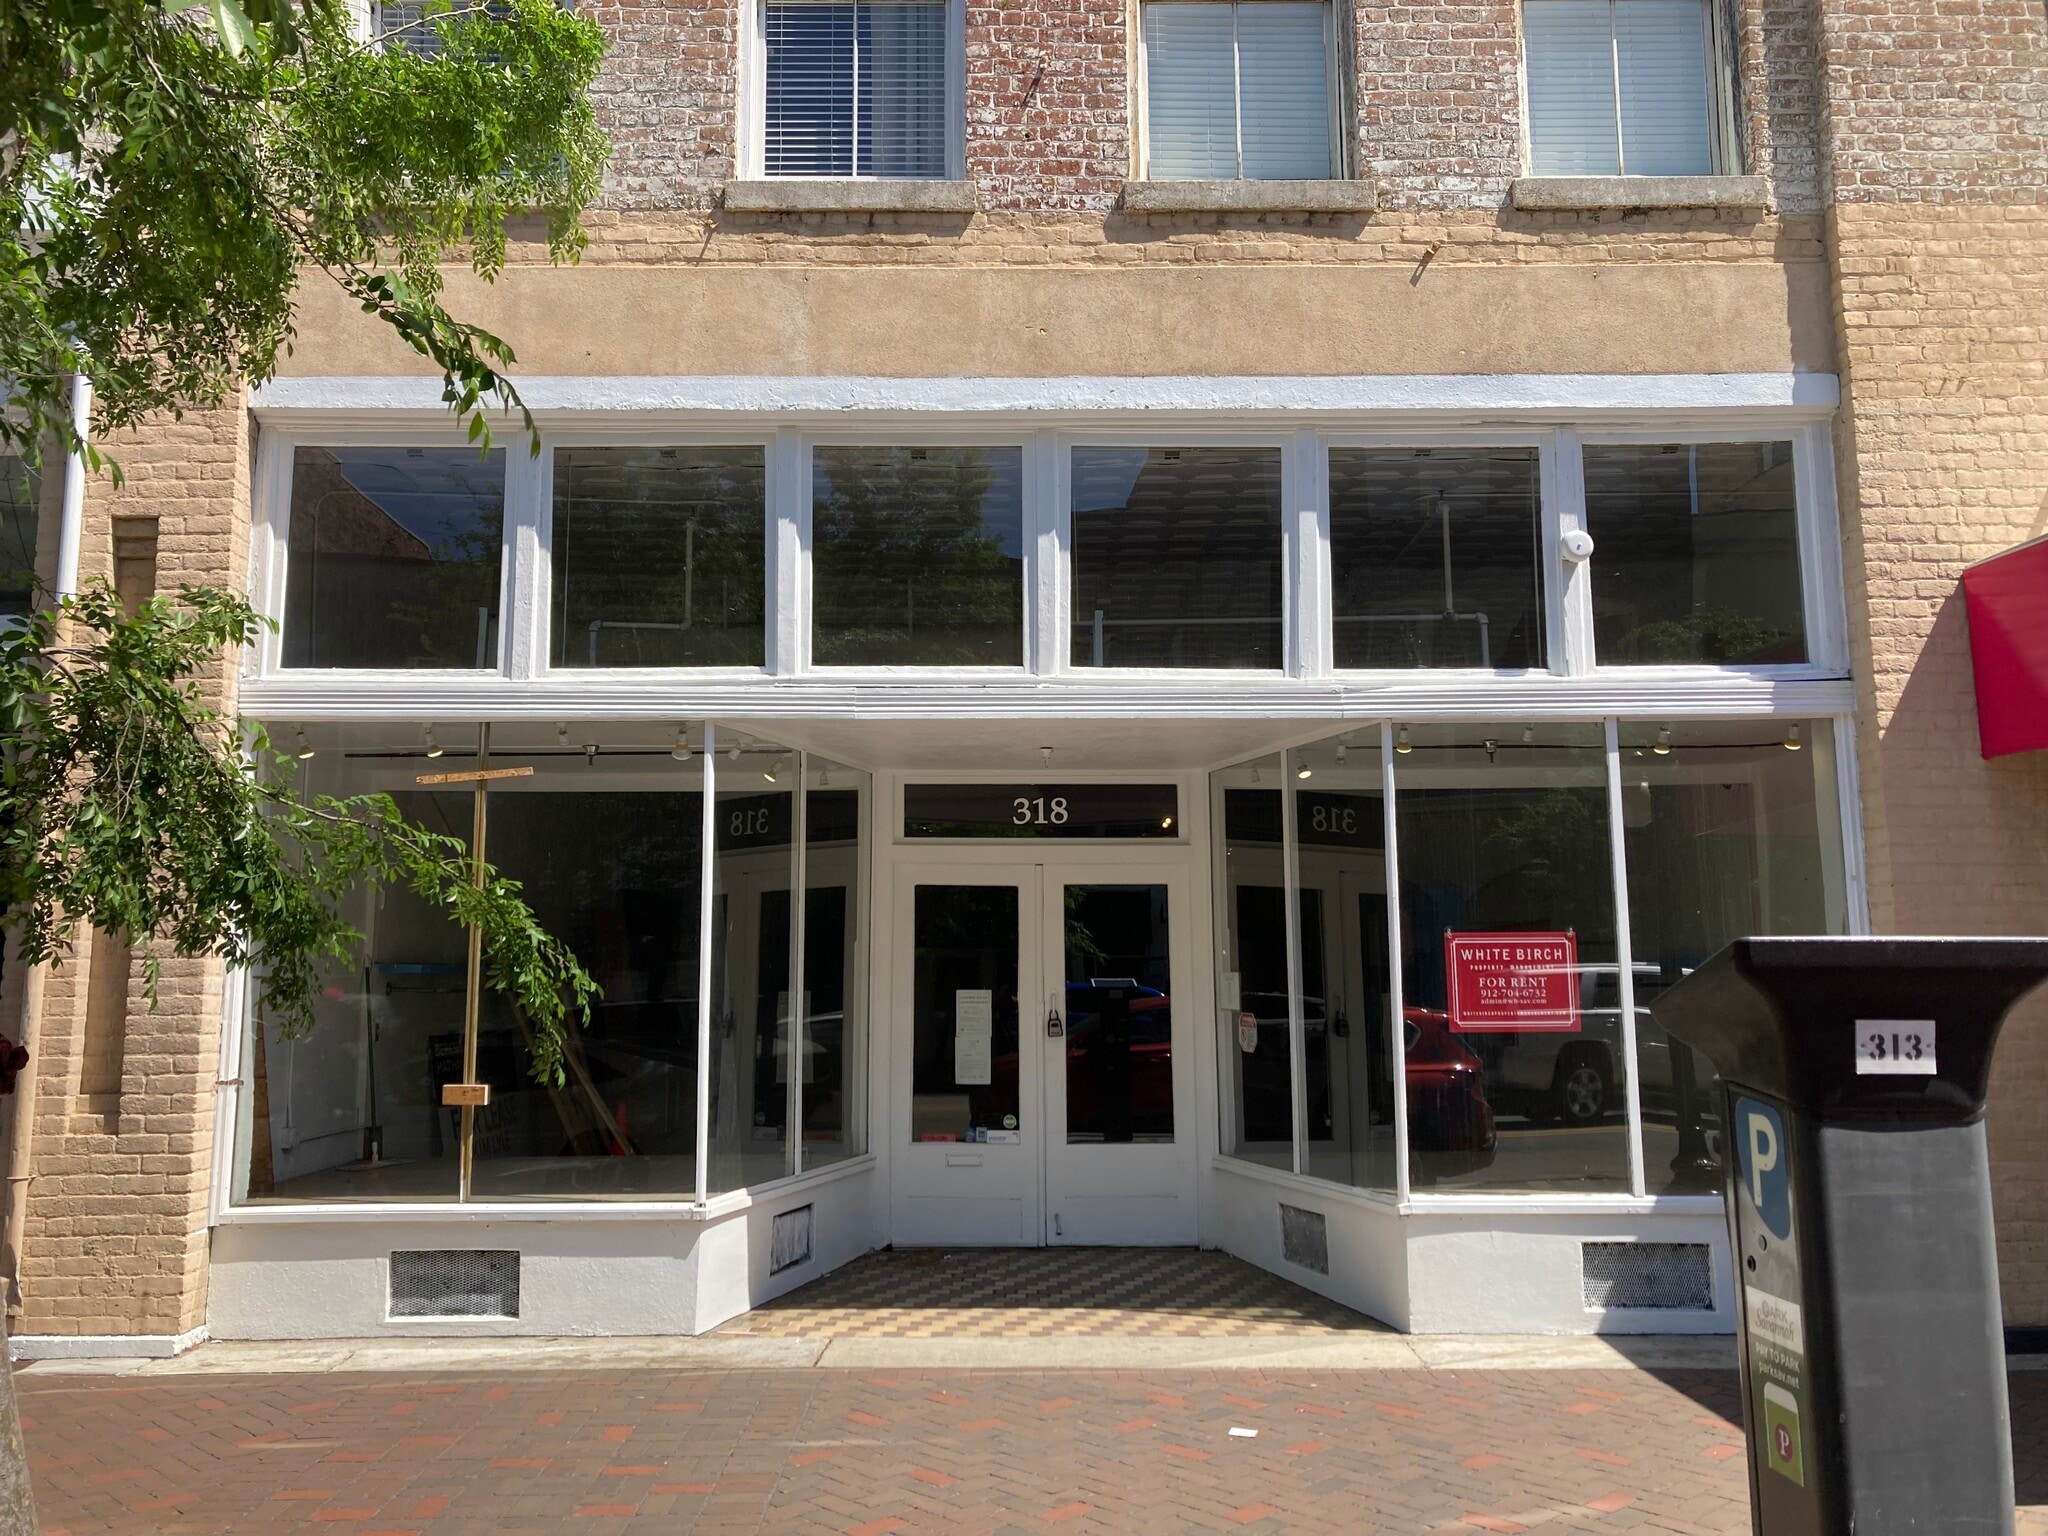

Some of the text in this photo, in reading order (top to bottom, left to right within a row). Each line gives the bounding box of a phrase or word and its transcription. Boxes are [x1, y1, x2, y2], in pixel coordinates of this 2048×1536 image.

[1013, 797, 1069, 825] 318
[1461, 948, 1562, 961] WHITE BIRCH
[1479, 977, 1547, 988] FOR RENT
[1481, 988, 1547, 998] 912-704-6732
[1869, 1033, 1923, 1061] 313
[1748, 1112, 1777, 1207] P
[1756, 1341, 1800, 1373] PAY TO PARK
[1759, 1361, 1800, 1389] parksav.net
[1779, 1429, 1790, 1456] P
